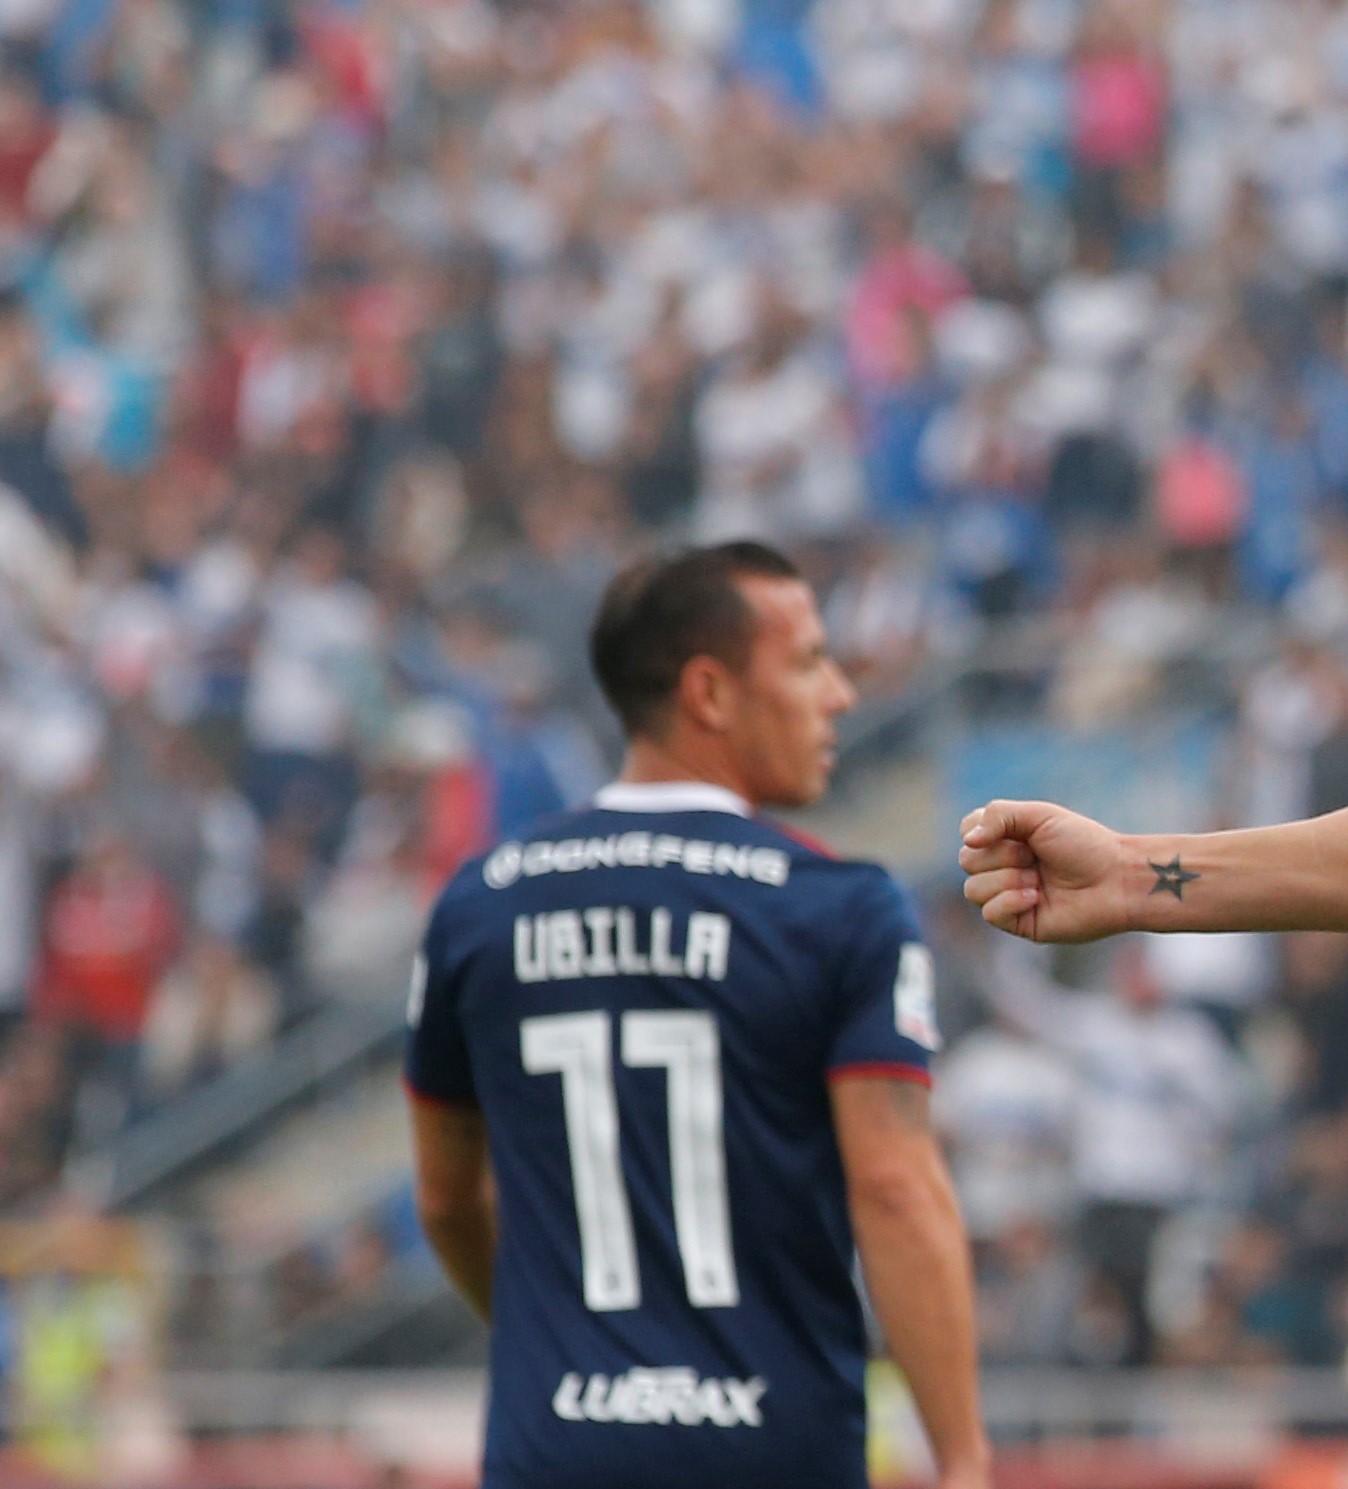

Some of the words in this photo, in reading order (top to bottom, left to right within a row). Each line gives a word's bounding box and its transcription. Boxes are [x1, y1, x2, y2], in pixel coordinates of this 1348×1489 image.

[513, 905, 731, 983] UBILLA
[518, 1009, 740, 1312] 11
[552, 1366, 767, 1427] LUBRAX
